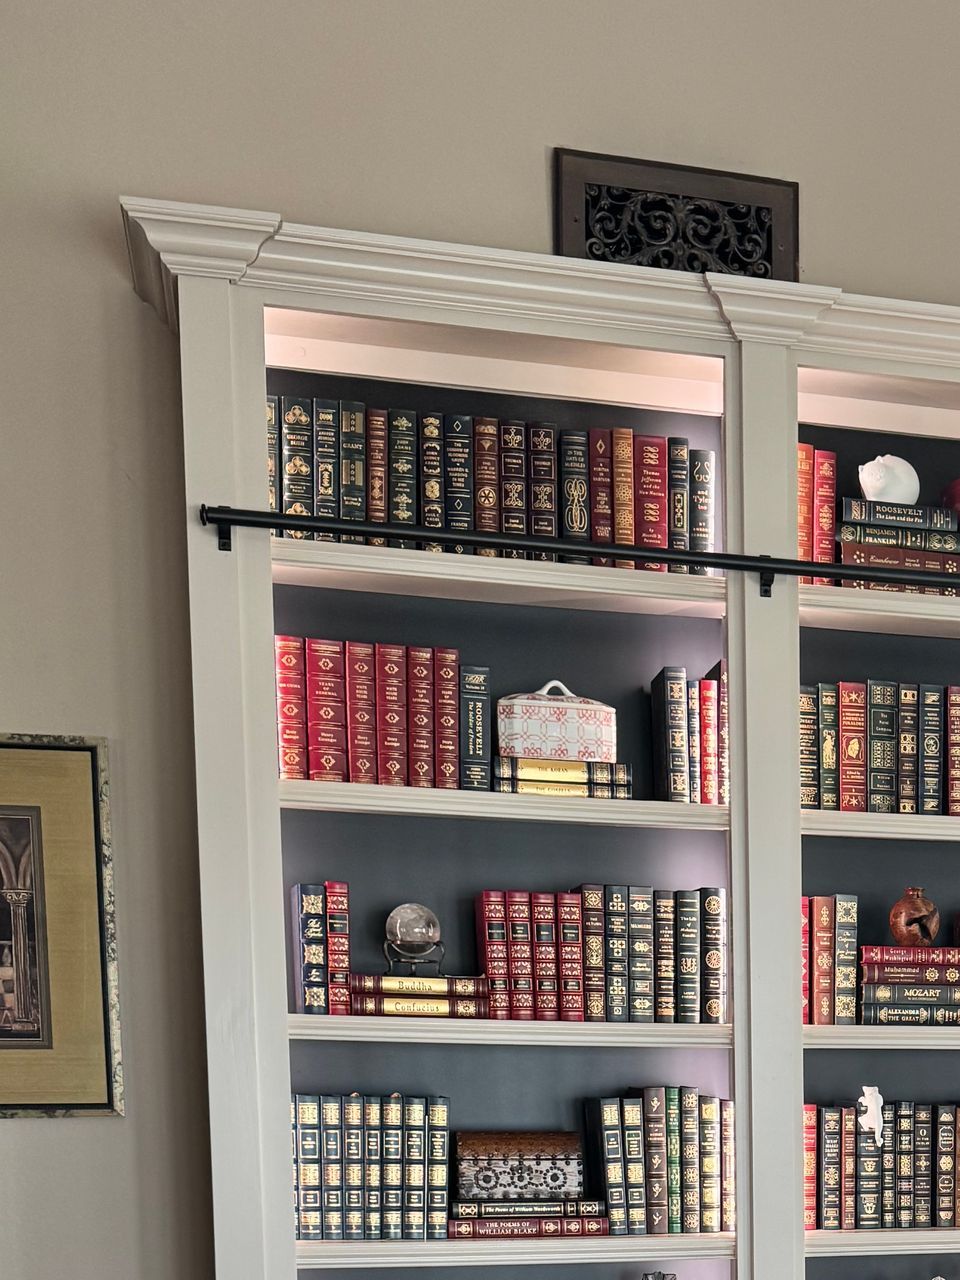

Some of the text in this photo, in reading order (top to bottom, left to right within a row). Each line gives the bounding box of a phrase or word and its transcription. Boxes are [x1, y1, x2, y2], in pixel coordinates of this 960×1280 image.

[875, 505, 924, 518] ROOSEVELT
[866, 528, 897, 538] BENJAMIN
[865, 536, 897, 546] FRANKLIN
[475, 701, 483, 756] ROOSEVELT
[884, 966, 920, 976] Muhammad
[397, 981, 434, 991] Buddha
[904, 988, 942, 998] MOZART
[394, 1003, 441, 1013] Confucius
[887, 1009, 920, 1017] ALEXANDER
[479, 1226, 538, 1235] WILLIAM BLAKE
